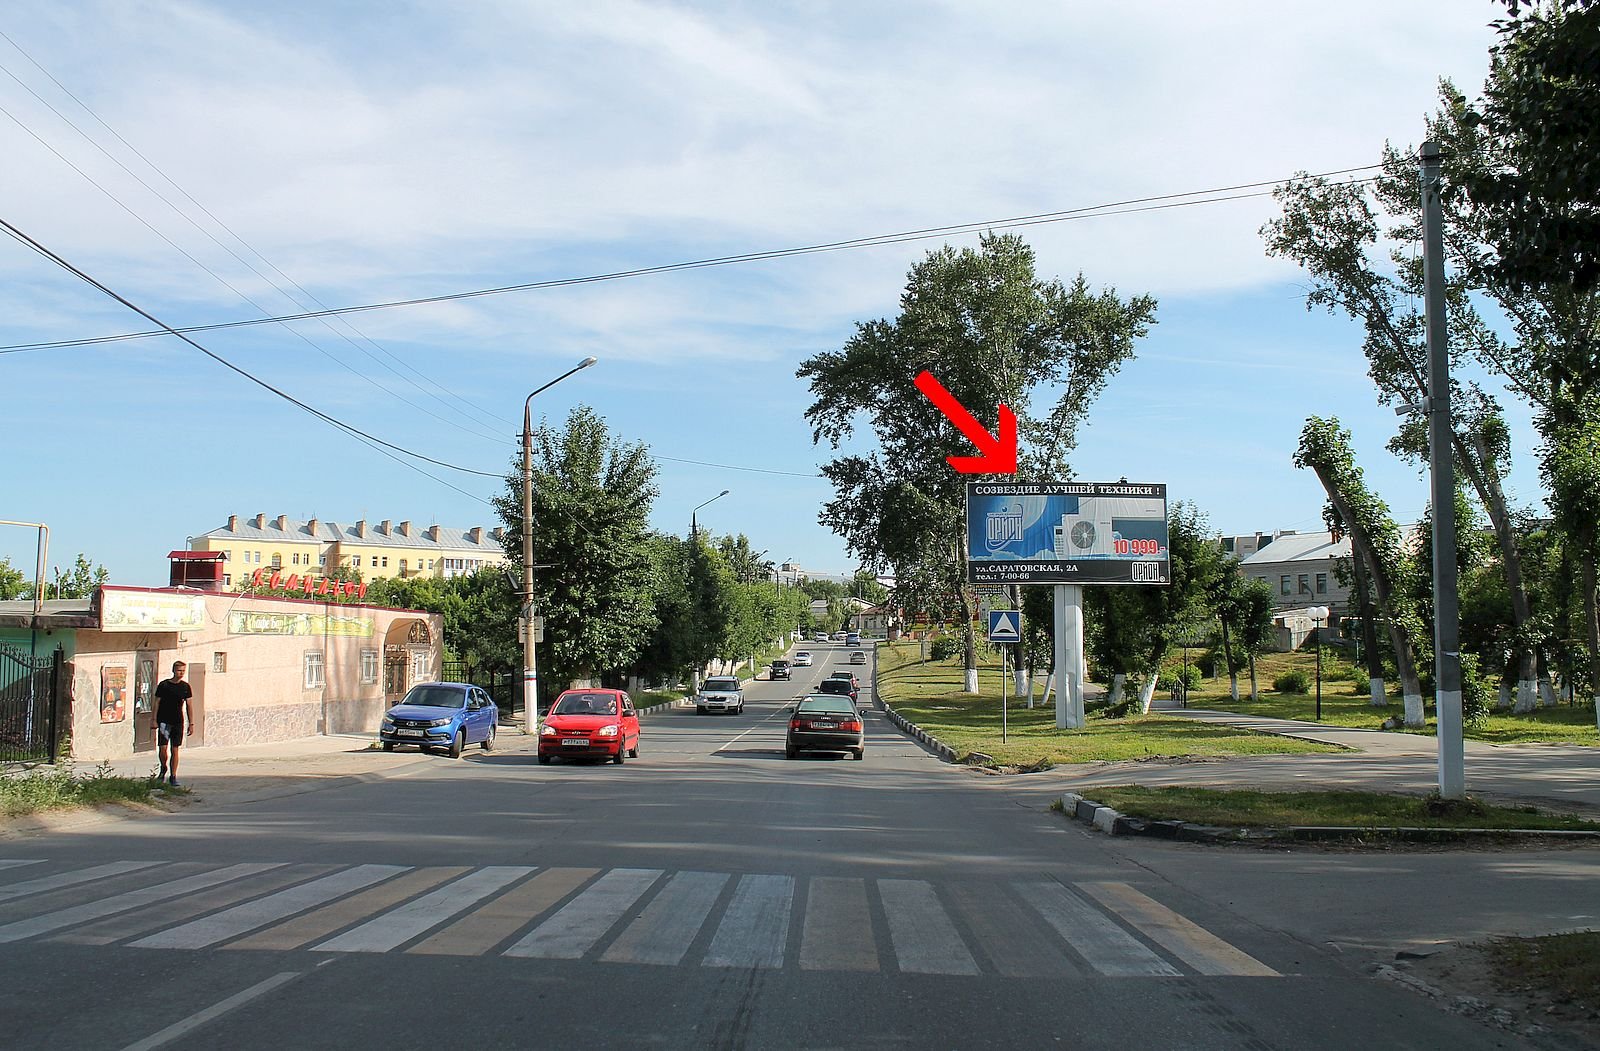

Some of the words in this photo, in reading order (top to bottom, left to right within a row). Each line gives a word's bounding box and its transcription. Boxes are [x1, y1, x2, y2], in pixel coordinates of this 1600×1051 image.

[975, 486, 1041, 495] СОЗВЕЗДИЕ
[1043, 483, 1096, 494] ЛУЧШЕЙ
[1098, 485, 1153, 495] ТЕХНИКИ
[988, 517, 1022, 541] ОРИОН
[1113, 539, 1129, 555] 10
[1000, 572, 1030, 580] 7-00-66
[1066, 564, 1079, 572] 2А
[1132, 562, 1159, 581] ОРИОН
[252, 567, 367, 599] КОМИЛЬФО
